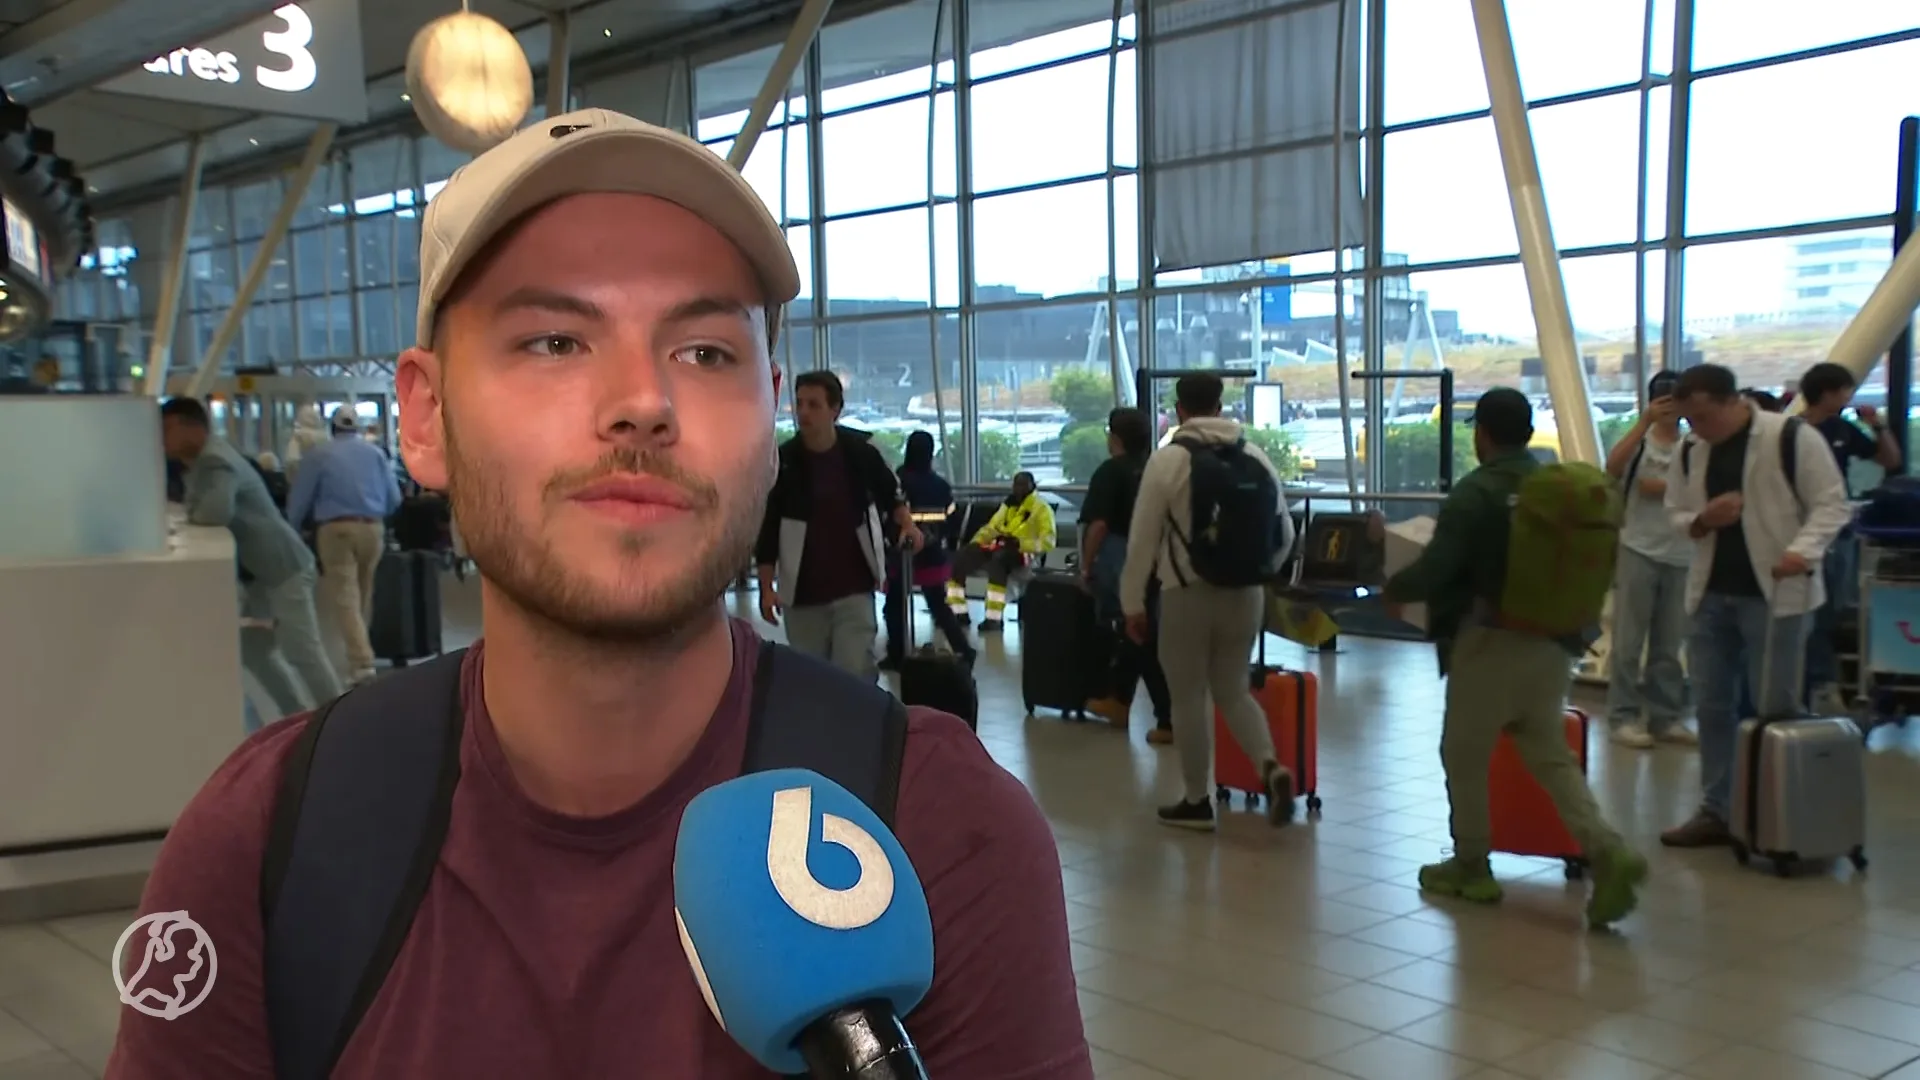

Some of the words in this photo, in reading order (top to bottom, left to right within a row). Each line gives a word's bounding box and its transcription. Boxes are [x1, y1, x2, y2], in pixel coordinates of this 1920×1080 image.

[256, 3, 317, 92] 3
[898, 362, 912, 388] 2
[767, 786, 895, 931] 6
